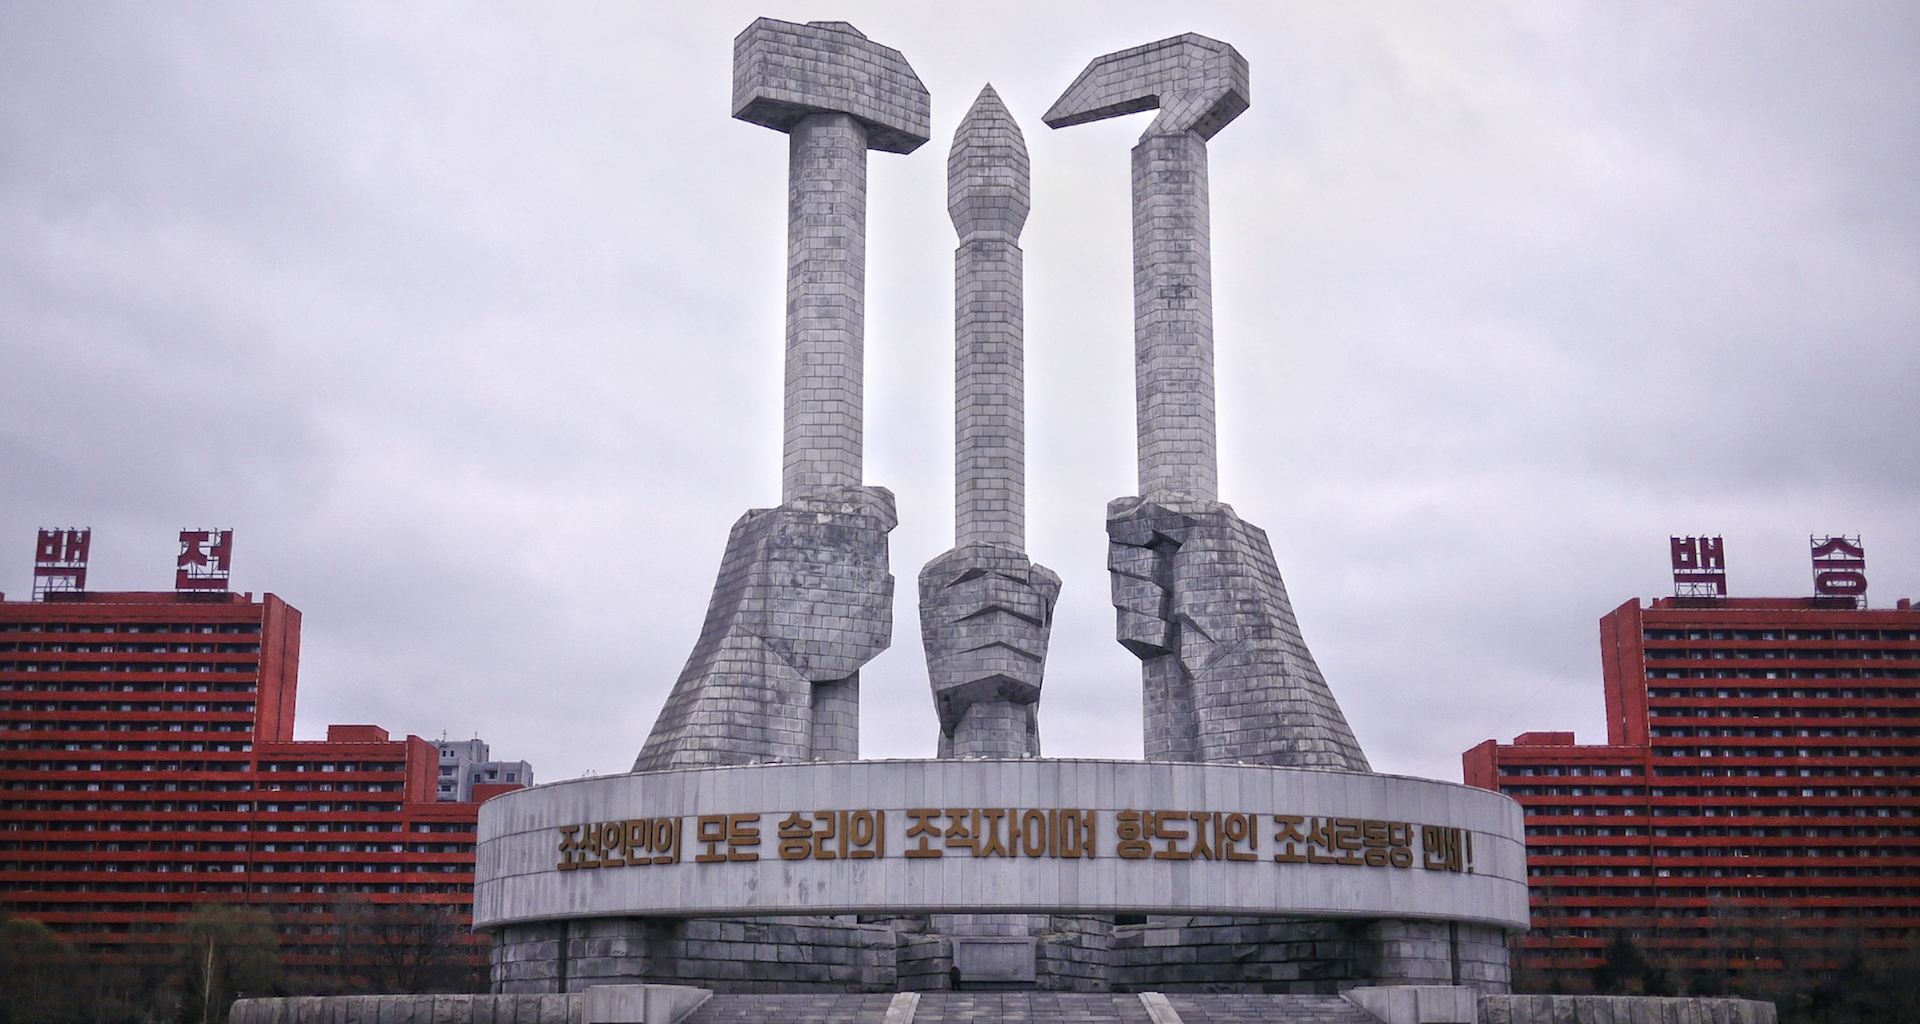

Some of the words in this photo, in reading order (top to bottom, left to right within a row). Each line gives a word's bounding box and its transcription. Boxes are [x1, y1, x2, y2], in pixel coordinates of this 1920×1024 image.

[557, 817, 682, 871] 조선인민의
[695, 813, 760, 862] 모든
[778, 810, 885, 861] 승리의
[905, 808, 1095, 859] 조직자이며
[1116, 808, 1258, 862] 향도자인
[1274, 814, 1415, 868] 조선로동당
[1422, 823, 1475, 873] 만세!
